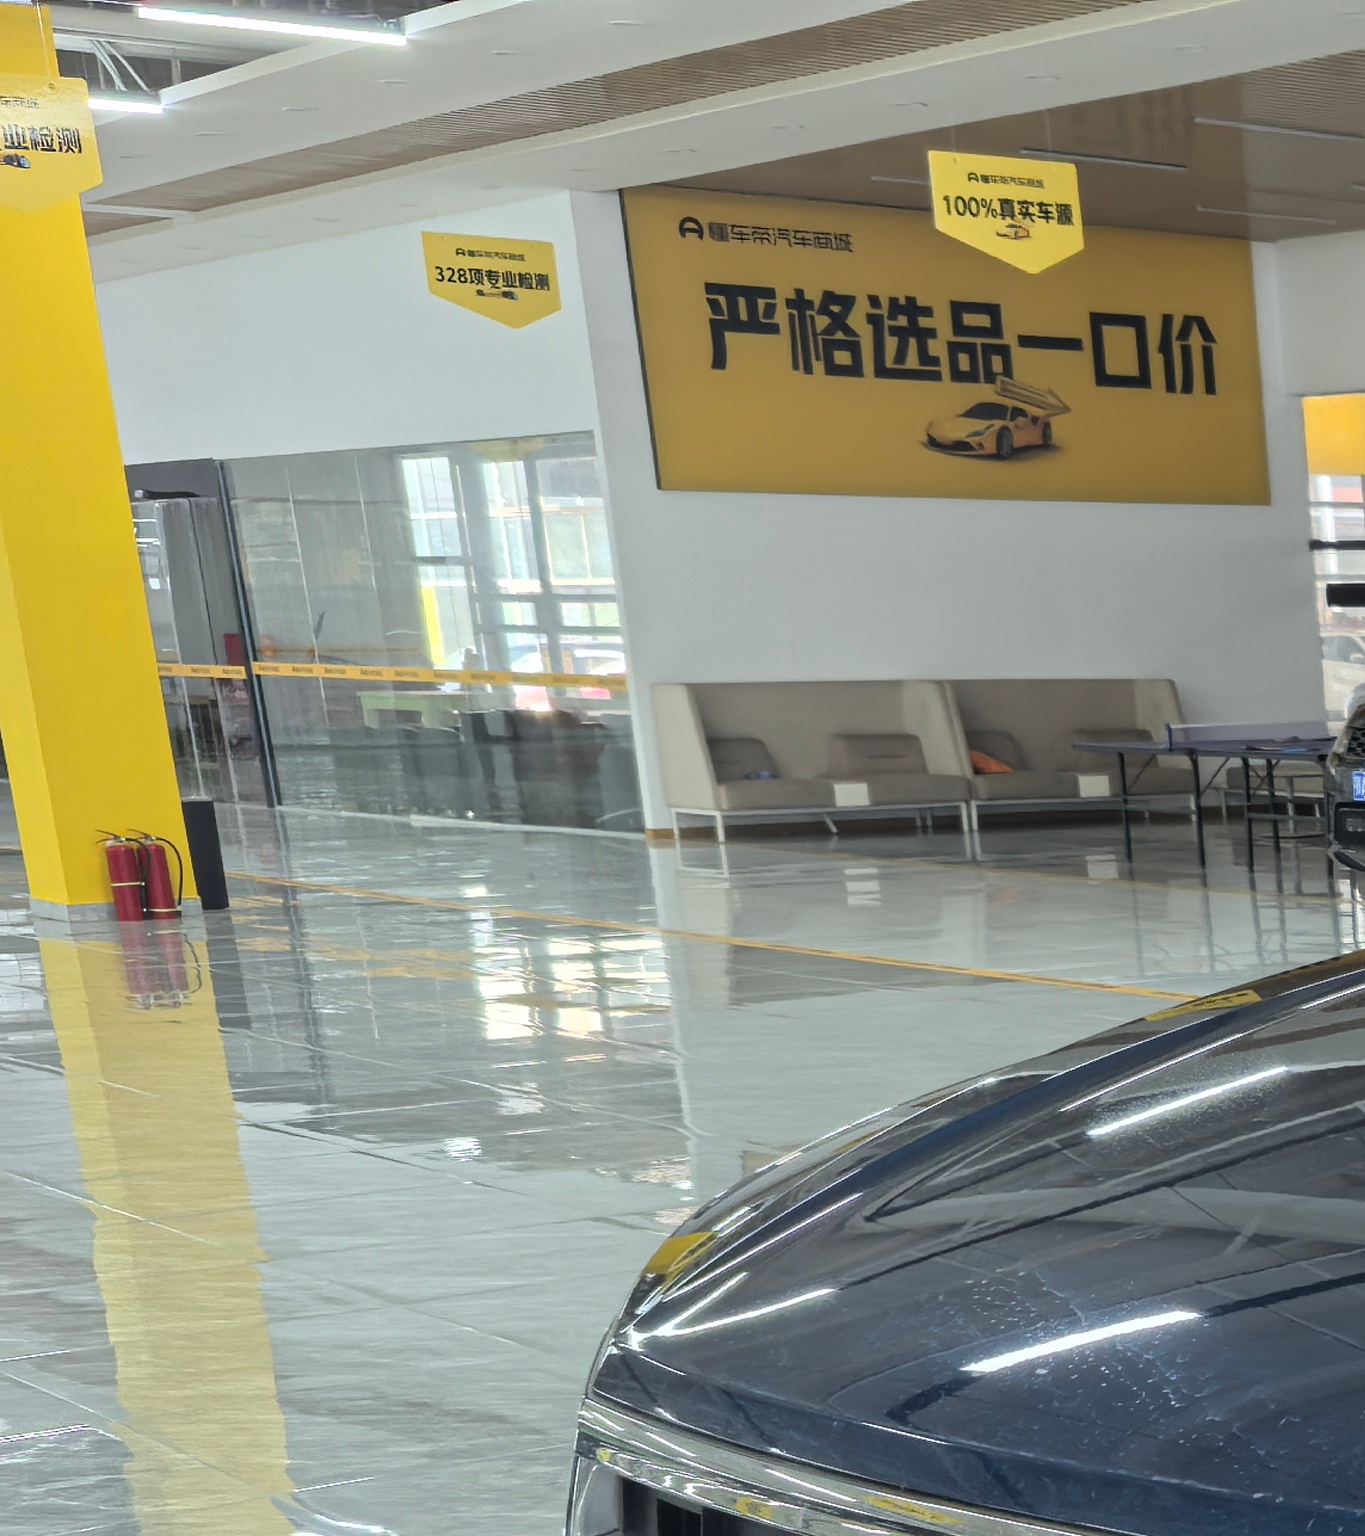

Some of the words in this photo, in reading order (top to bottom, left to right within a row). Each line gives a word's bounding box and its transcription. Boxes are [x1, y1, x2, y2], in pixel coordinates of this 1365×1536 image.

[0, 124, 82, 154] 业检测
[942, 195, 1075, 226] 100%真实车源
[434, 265, 550, 291] 328项专业检测
[703, 281, 1219, 396] 严格选品一口价
